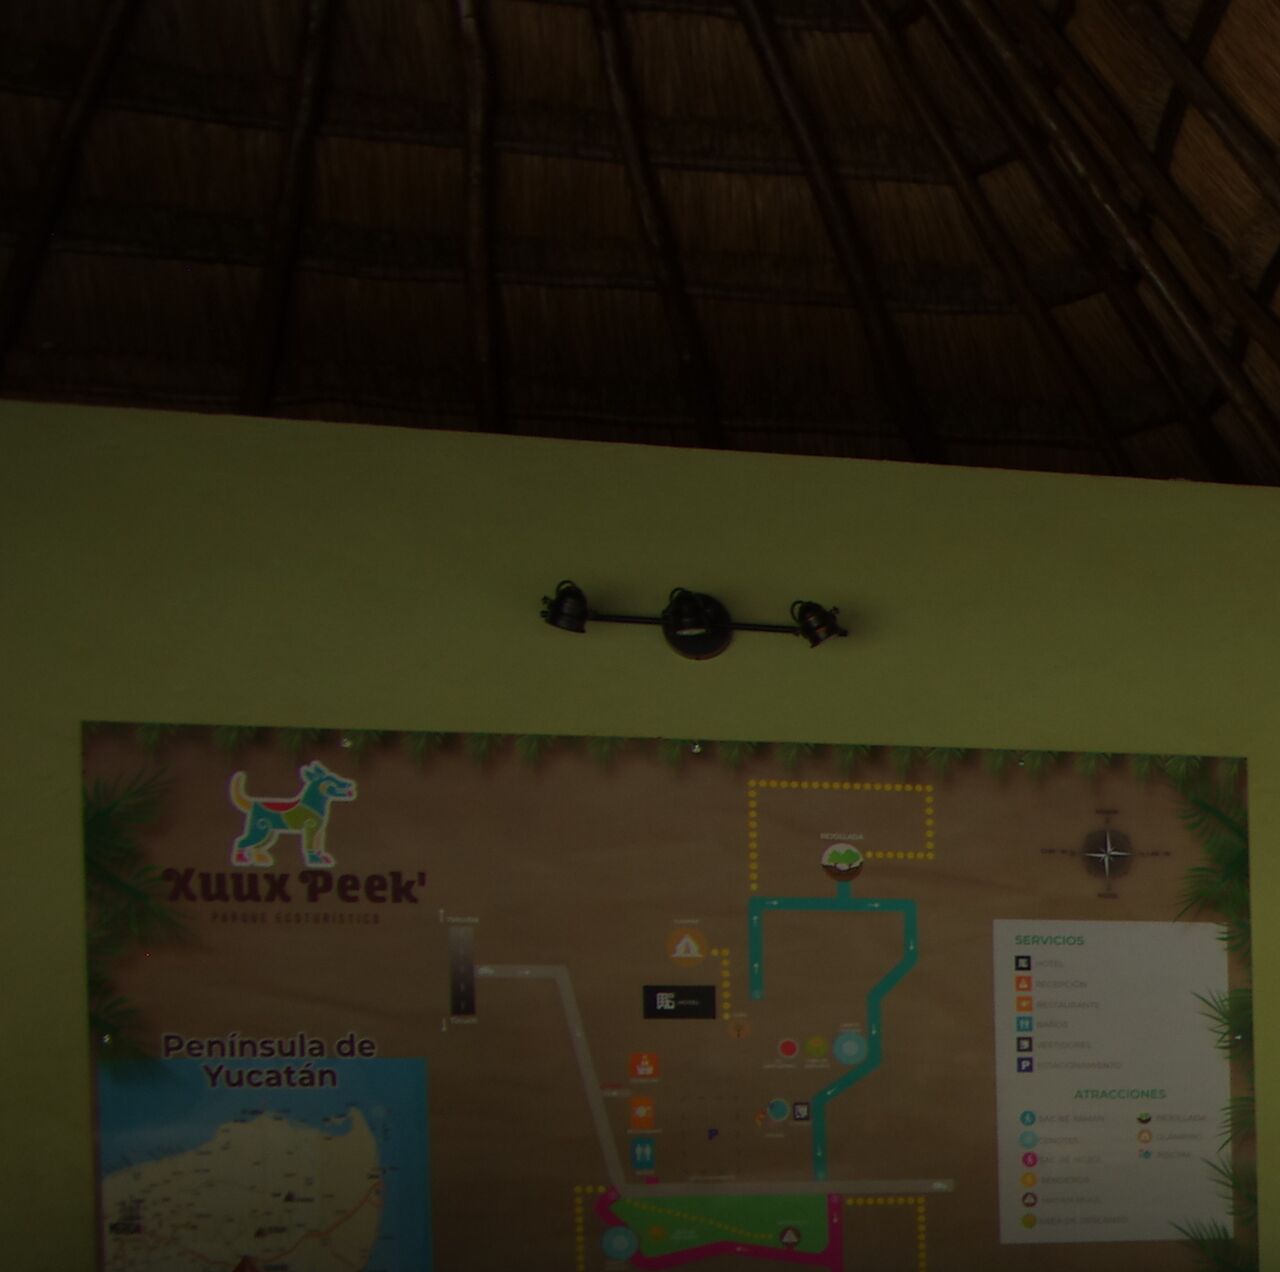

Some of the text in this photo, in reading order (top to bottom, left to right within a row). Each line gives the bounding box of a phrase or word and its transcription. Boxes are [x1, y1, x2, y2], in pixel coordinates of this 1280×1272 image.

[161, 867, 427, 904] Xuux Peek'
[210, 911, 267, 925] PARQUE
[1014, 935, 1085, 946] SERVICIOS
[1036, 1001, 1100, 1009] RESTAURANTE
[162, 1032, 376, 1059] Península de
[204, 1063, 338, 1088] Yucatán
[1073, 1088, 1167, 1100] ATRACCIONES
